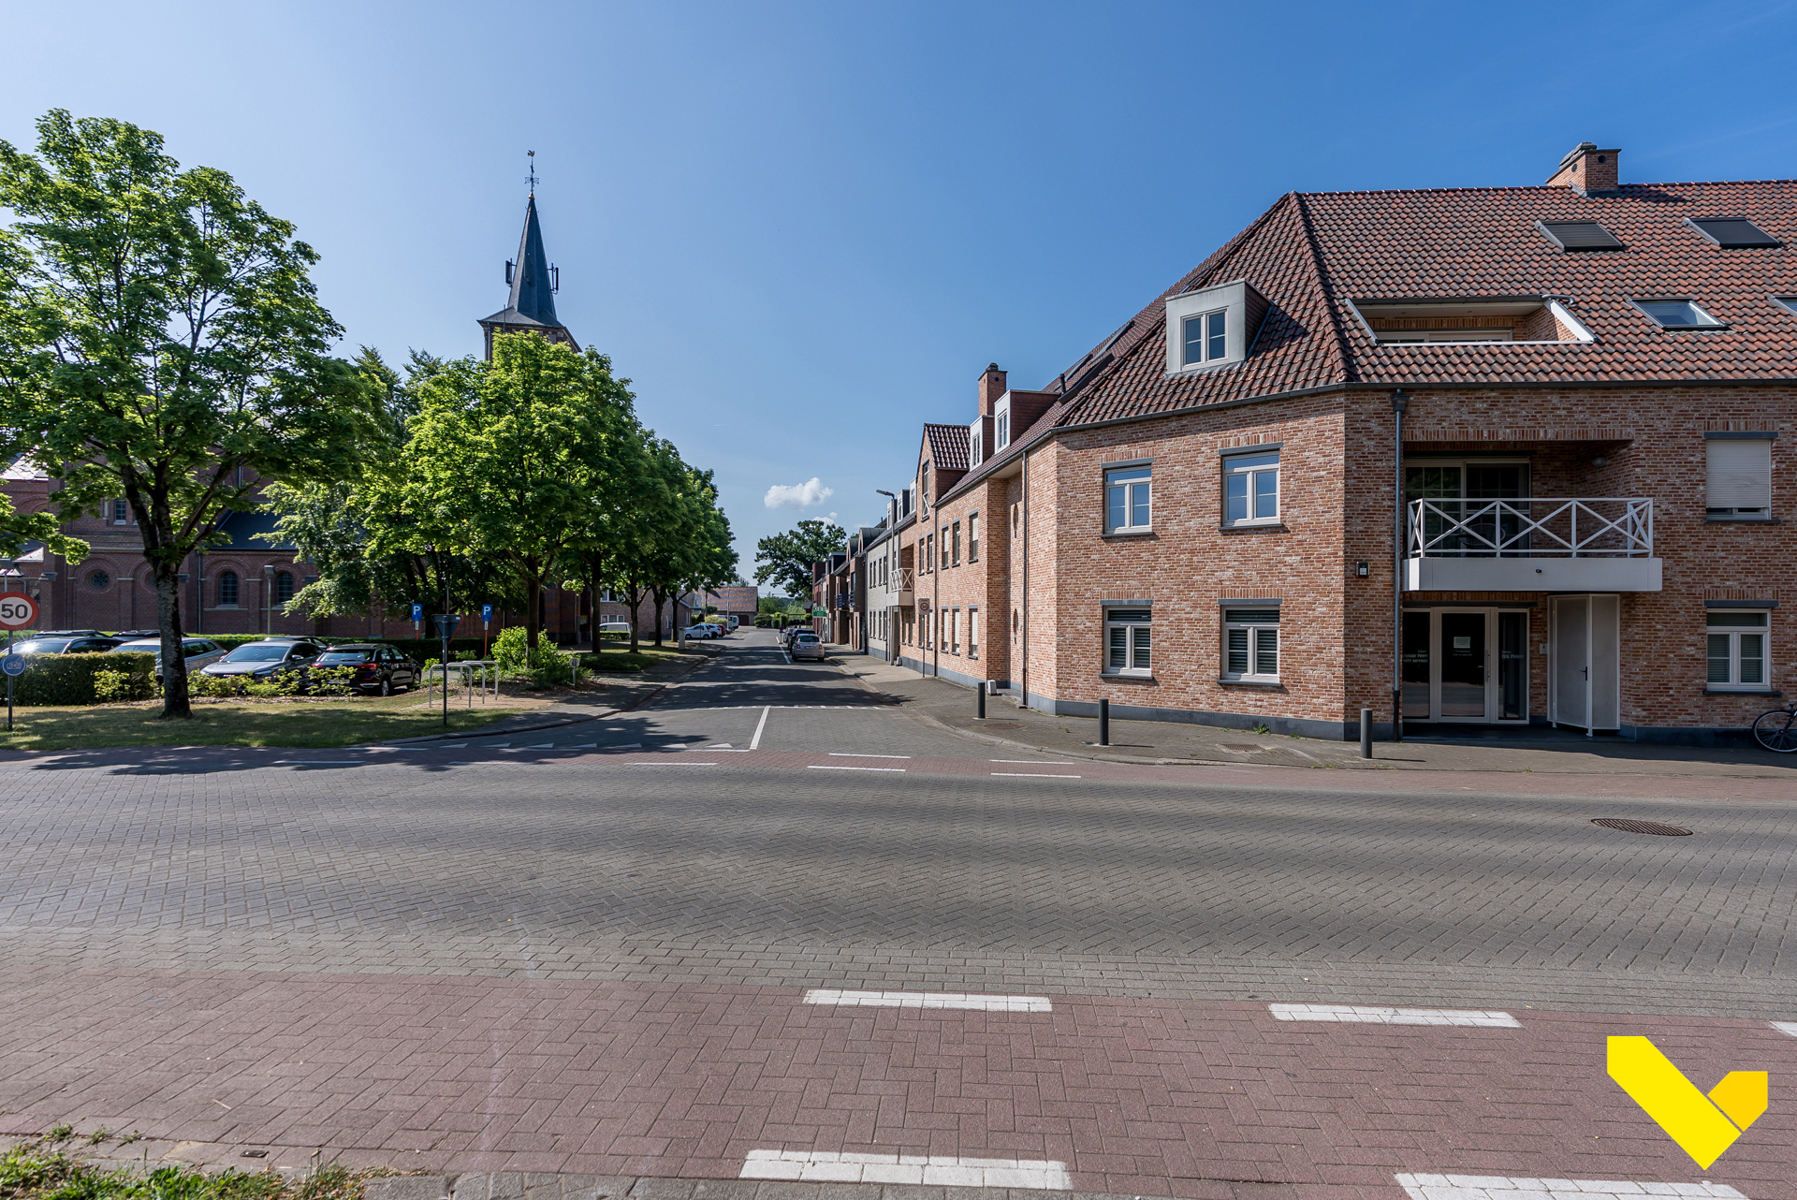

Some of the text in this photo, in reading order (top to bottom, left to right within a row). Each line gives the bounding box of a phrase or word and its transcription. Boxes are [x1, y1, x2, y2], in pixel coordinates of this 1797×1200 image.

[1, 603, 28, 619] 50
[413, 605, 421, 615] P
[483, 606, 491, 615] P
